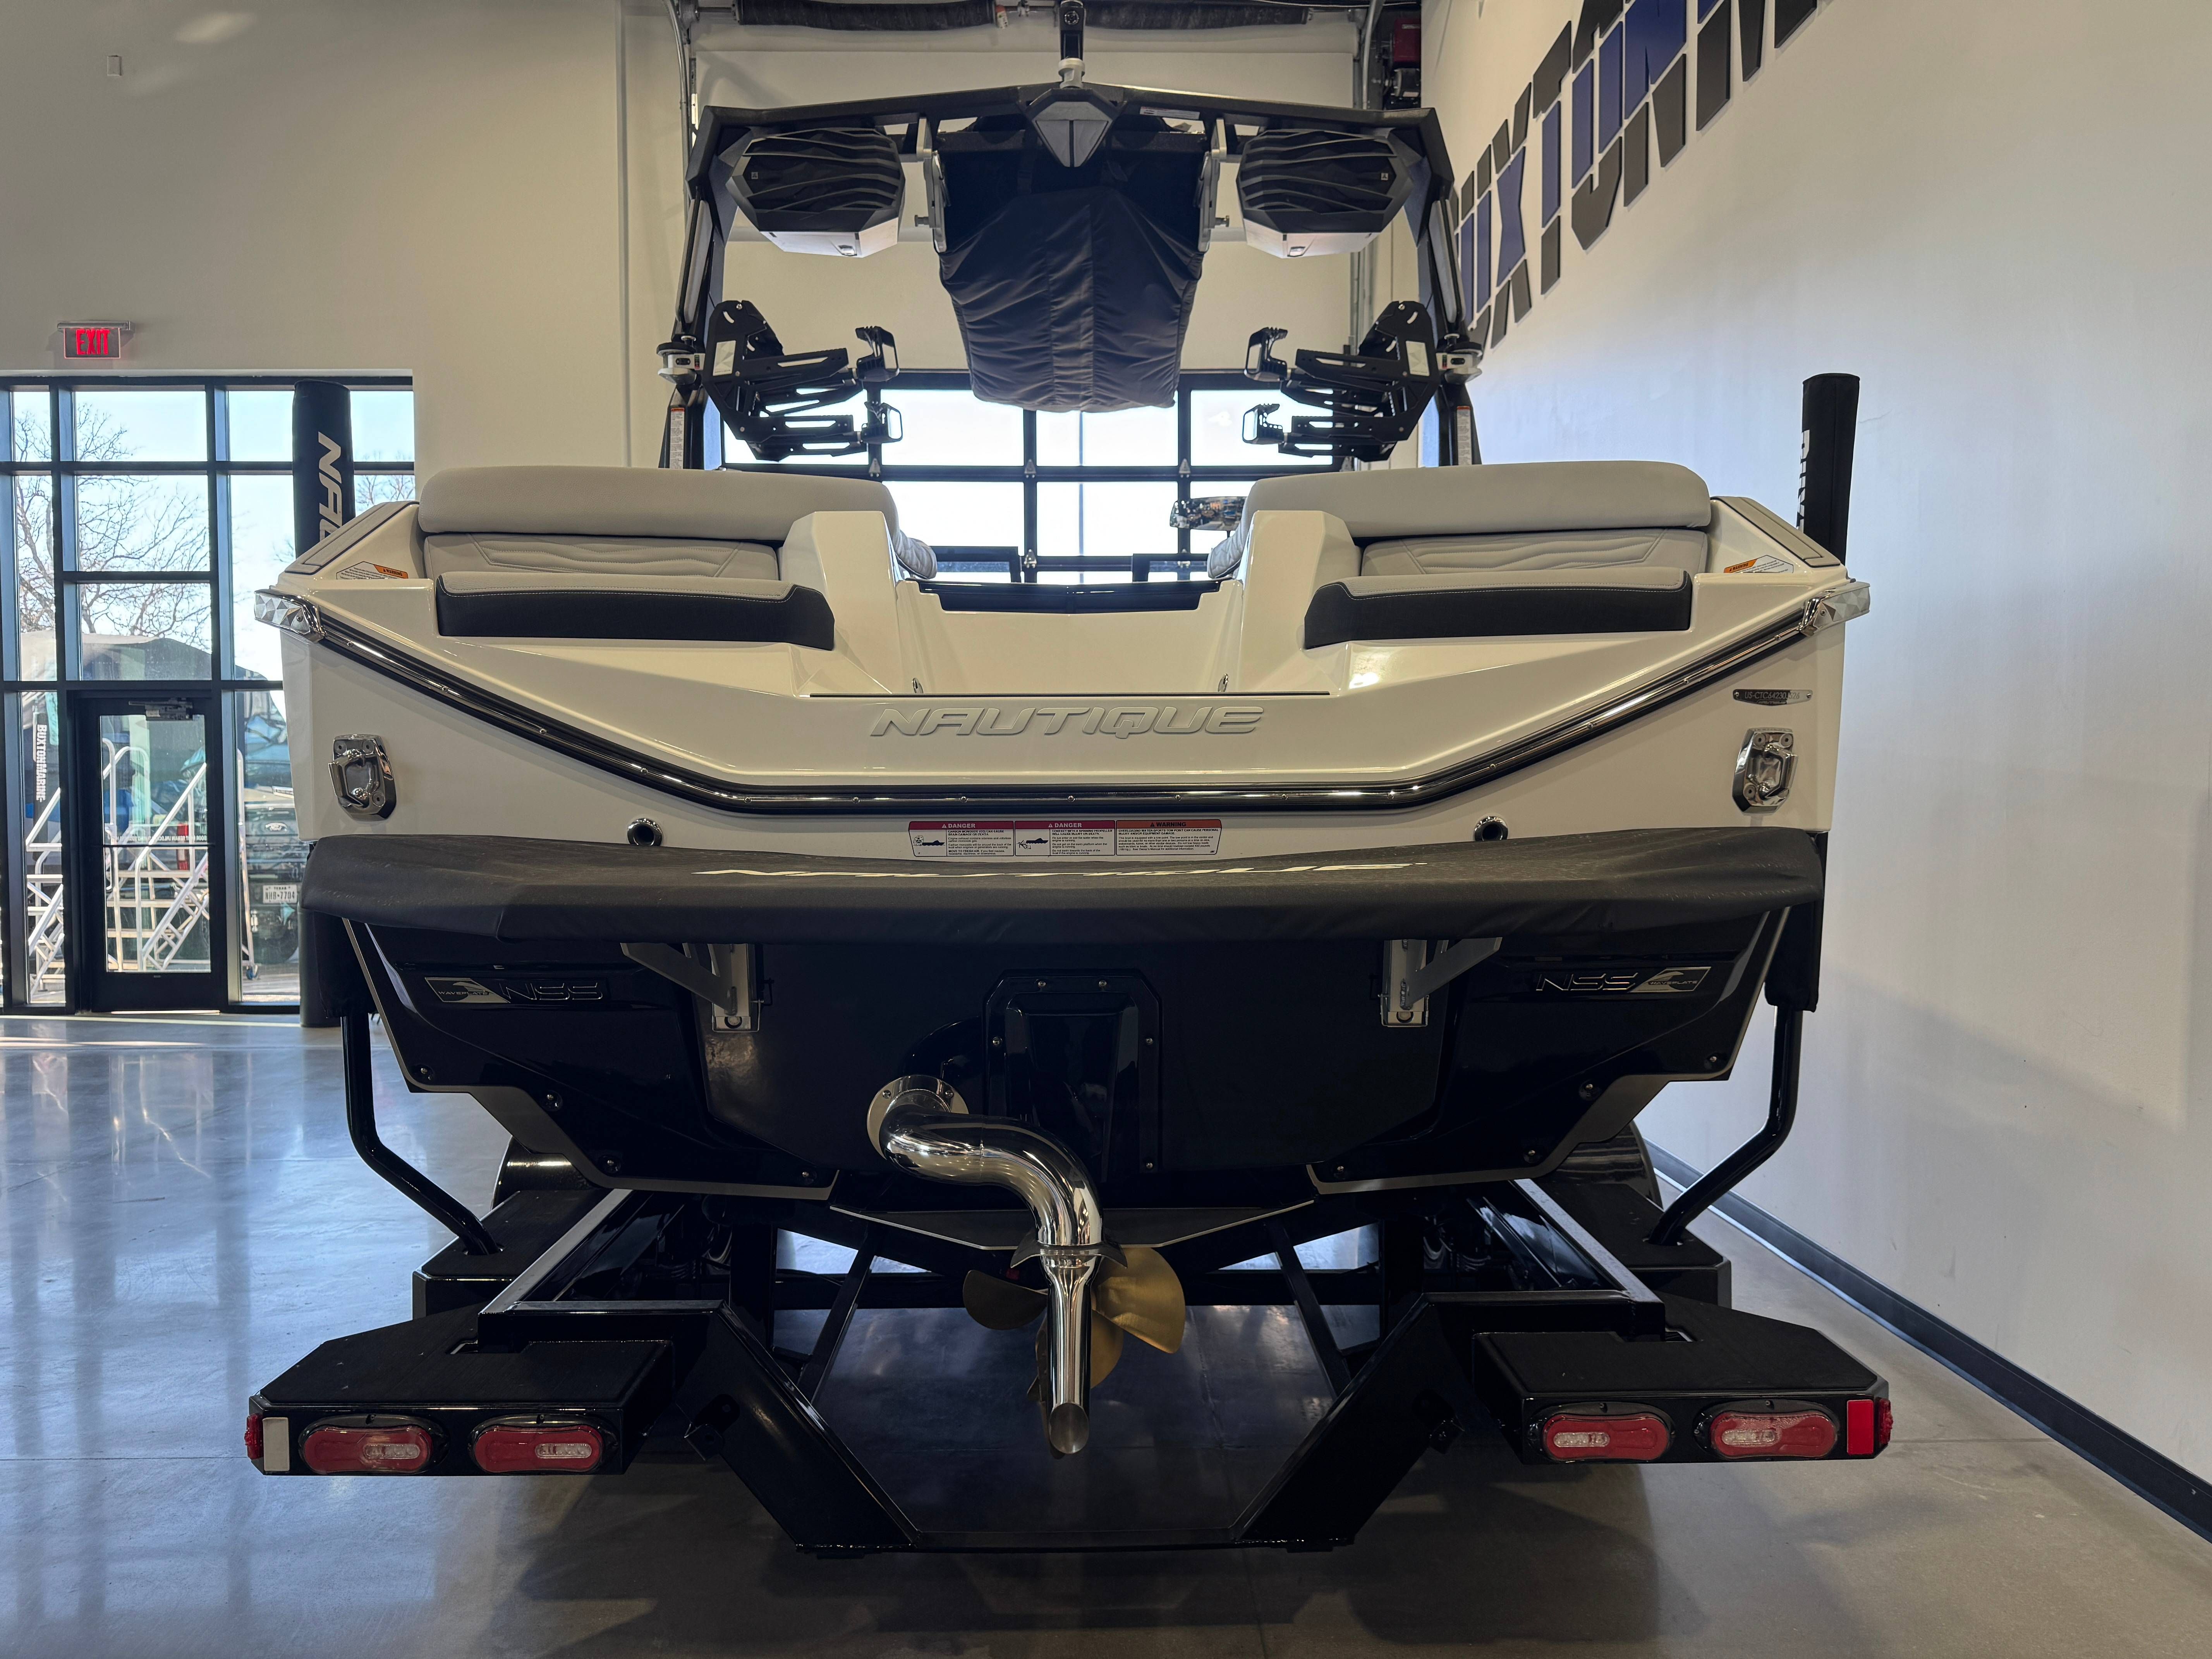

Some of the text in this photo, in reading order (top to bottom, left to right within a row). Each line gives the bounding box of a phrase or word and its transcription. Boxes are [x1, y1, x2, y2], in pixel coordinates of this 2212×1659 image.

[76, 329, 110, 355] EXIT
[870, 706, 1264, 739] NAUTIQUE
[498, 982, 603, 1001] NSS
[1535, 972, 1638, 992] NSS
